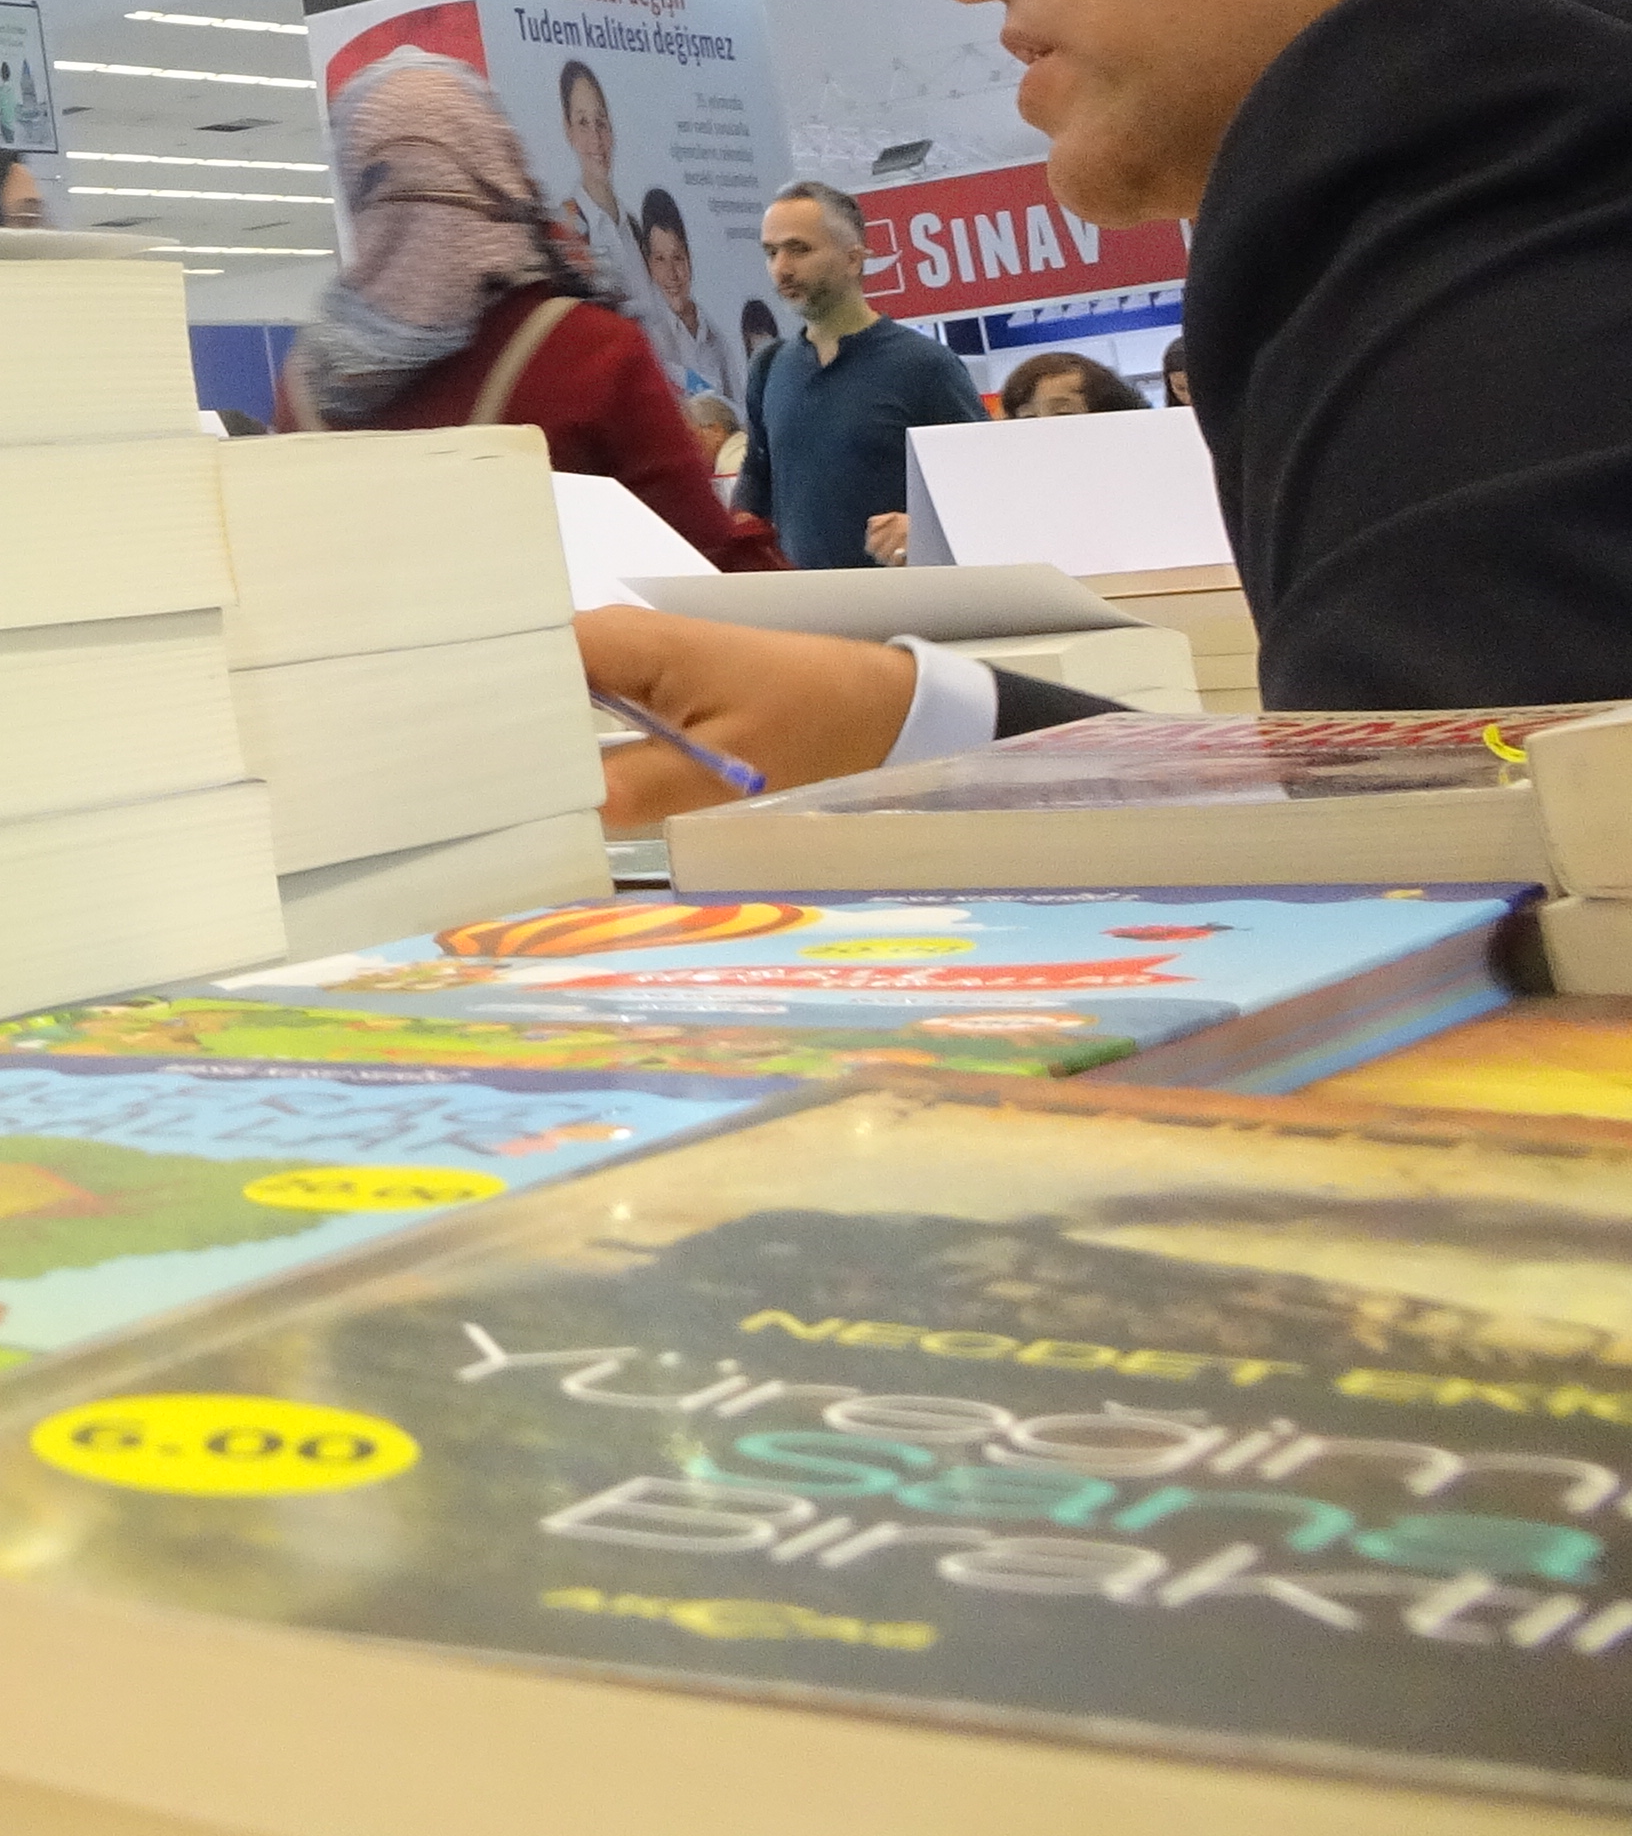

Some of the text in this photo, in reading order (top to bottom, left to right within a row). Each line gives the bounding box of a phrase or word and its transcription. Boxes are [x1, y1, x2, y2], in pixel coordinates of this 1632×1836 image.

[514, 7, 736, 66] Tudem kalitesi değişmez
[909, 205, 1100, 288] SINAV
[70, 1417, 378, 1463] 6.00
[462, 1321, 1632, 1518] Yüreğim
